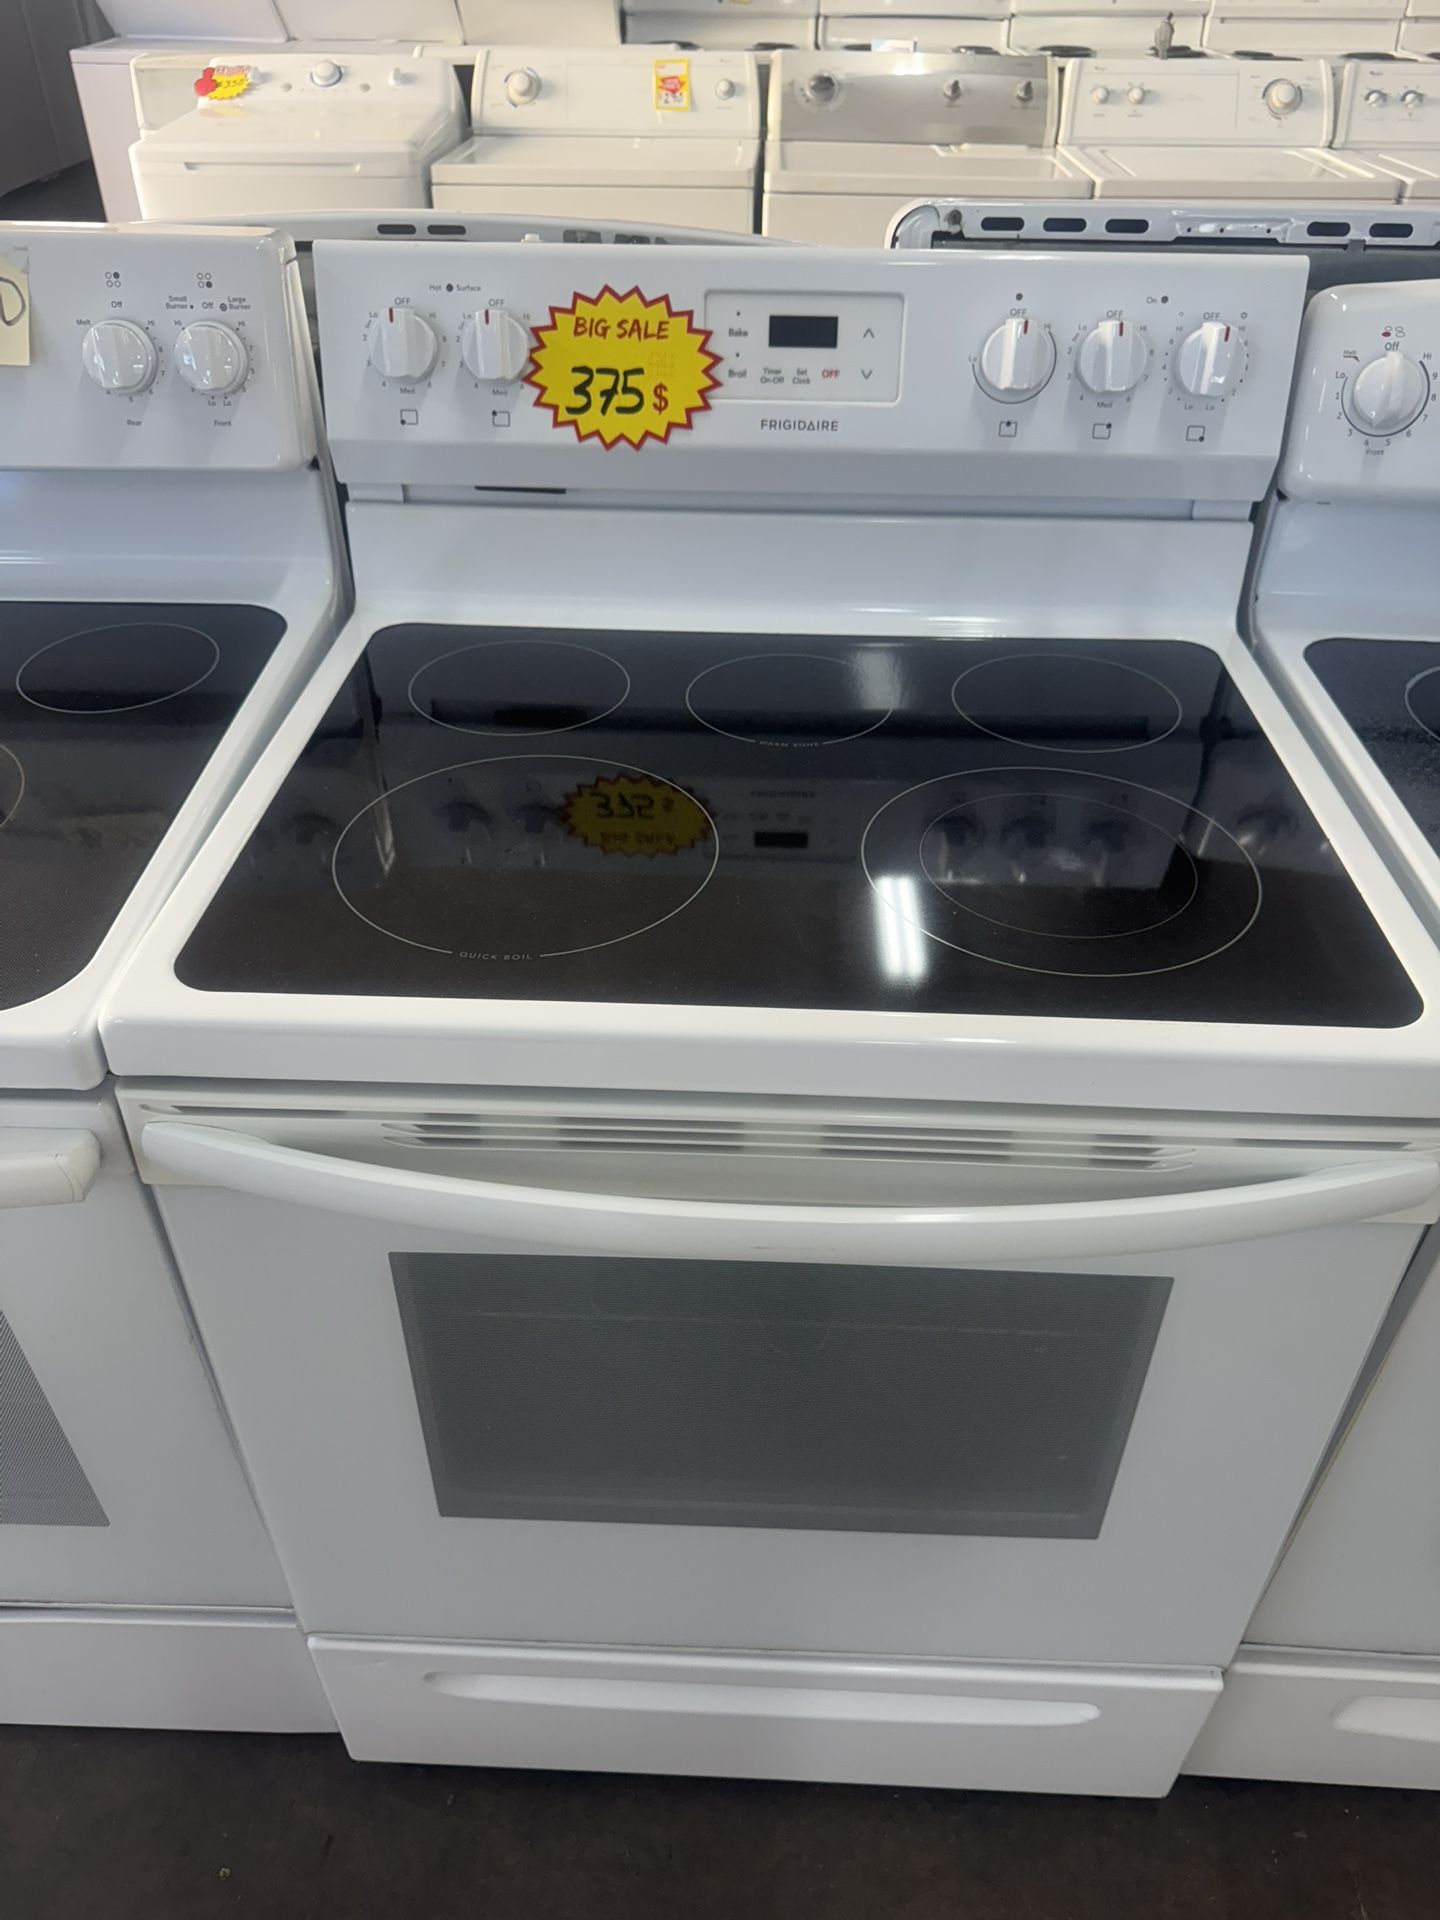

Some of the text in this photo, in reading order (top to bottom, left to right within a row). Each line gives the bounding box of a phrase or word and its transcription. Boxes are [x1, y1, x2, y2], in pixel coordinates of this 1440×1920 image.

[227, 296, 246, 304] Large
[394, 297, 411, 306] OFF
[488, 298, 505, 307] OFF
[111, 301, 123, 309] Off
[165, 302, 188, 310] Burner
[1010, 308, 1027, 317] OFF
[1106, 310, 1124, 318] OFF
[1203, 312, 1221, 320] OFF
[573, 317, 670, 343] BIG SALE
[728, 328, 748, 337] Bake
[1384, 342, 1400, 351] Off
[1423, 352, 1432, 360] Hi
[728, 369, 747, 378] Broil
[763, 368, 782, 376] Timer
[797, 368, 808, 376] Set
[822, 370, 840, 378] OFF
[792, 377, 810, 385] Clock
[565, 366, 669, 416] 375 $
[760, 419, 839, 432] FRIGIDAIRE
[459, 951, 533, 961] QUICK BOIL
